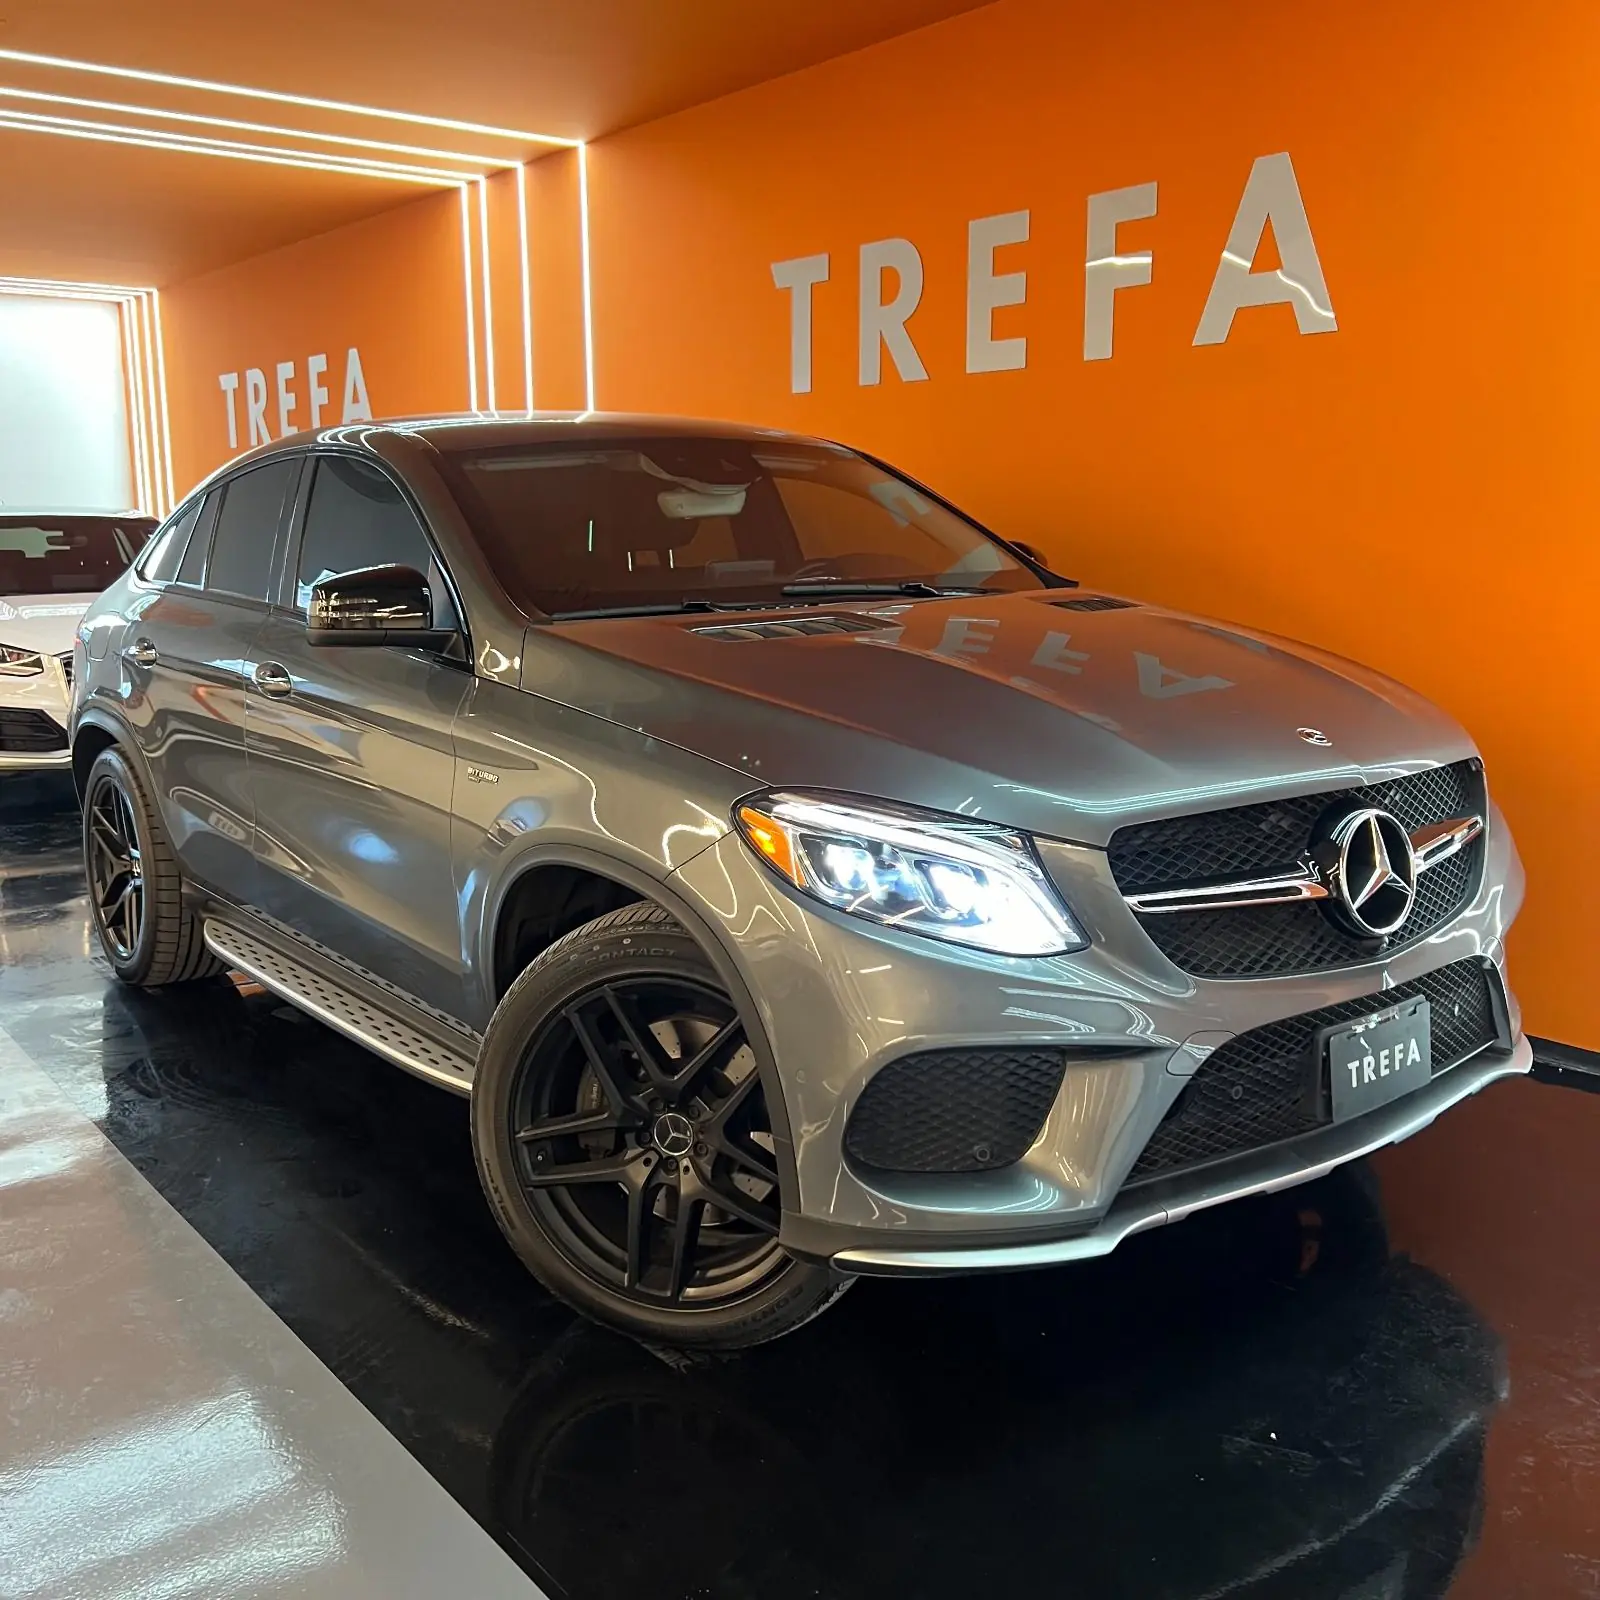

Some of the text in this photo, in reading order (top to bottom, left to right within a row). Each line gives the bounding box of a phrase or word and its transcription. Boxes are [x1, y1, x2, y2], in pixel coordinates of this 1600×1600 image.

[771, 152, 1338, 394] TREFA
[219, 348, 373, 449] TREFA
[1347, 1038, 1421, 1089] TREFA
